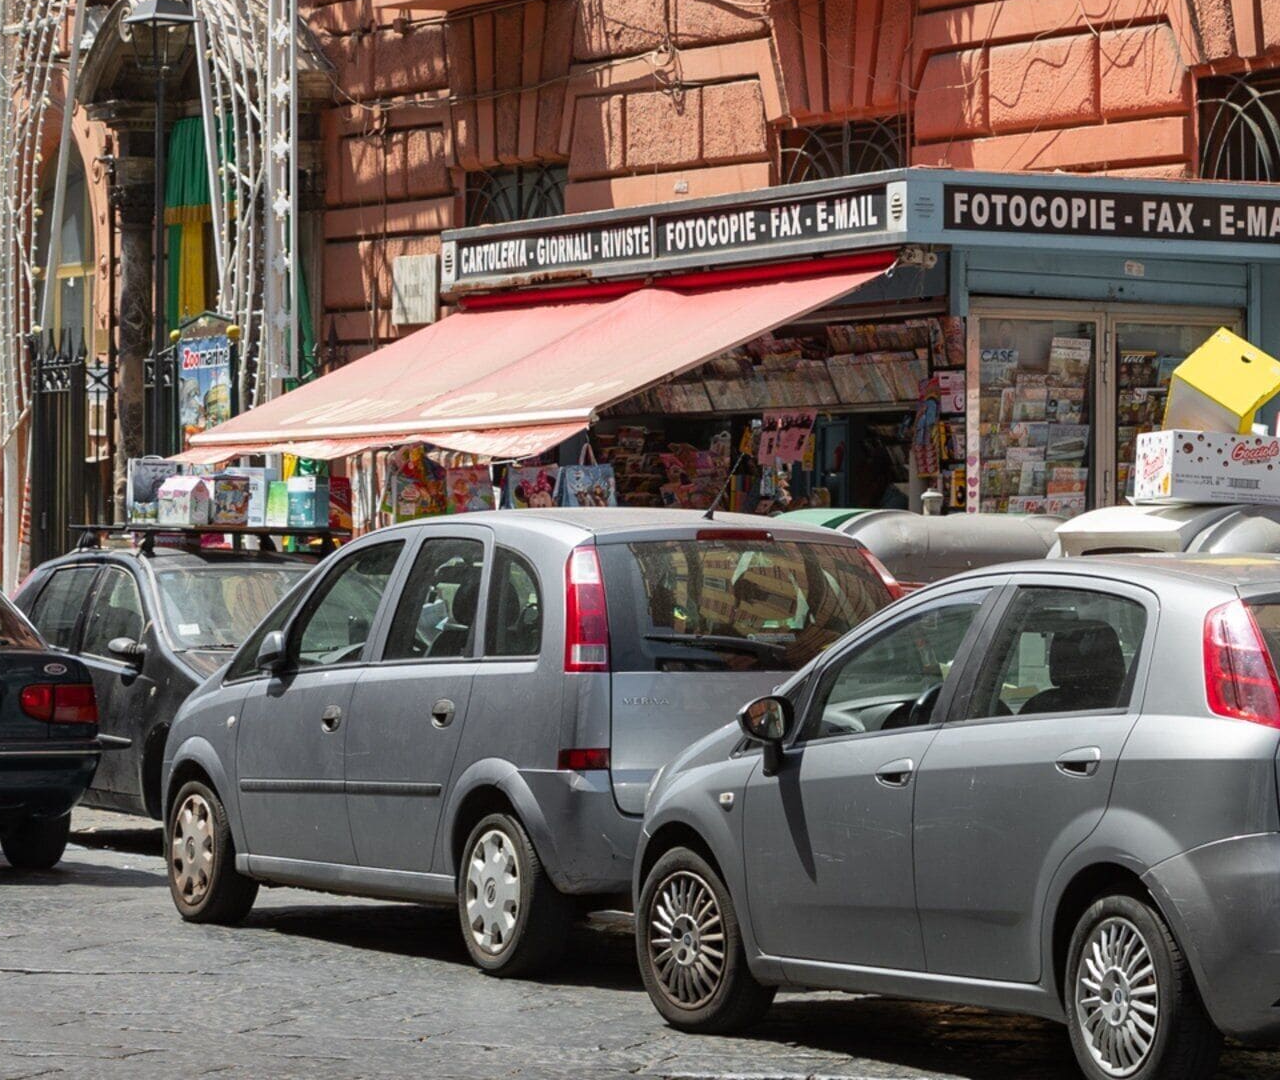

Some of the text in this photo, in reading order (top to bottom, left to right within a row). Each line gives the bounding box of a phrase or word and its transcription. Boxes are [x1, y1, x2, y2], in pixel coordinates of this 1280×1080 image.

[665, 210, 756, 252] FOTOCOPIE
[770, 203, 802, 238] FAX
[817, 194, 878, 233] E-MAIL
[953, 192, 1116, 231] FOTOCOPIE
[1142, 201, 1195, 234] FAX
[461, 243, 528, 274] CARTOLERIA
[536, 236, 592, 265] GIORNALI
[600, 225, 650, 258] RIVISTE
[182, 346, 229, 369] Zoomarine
